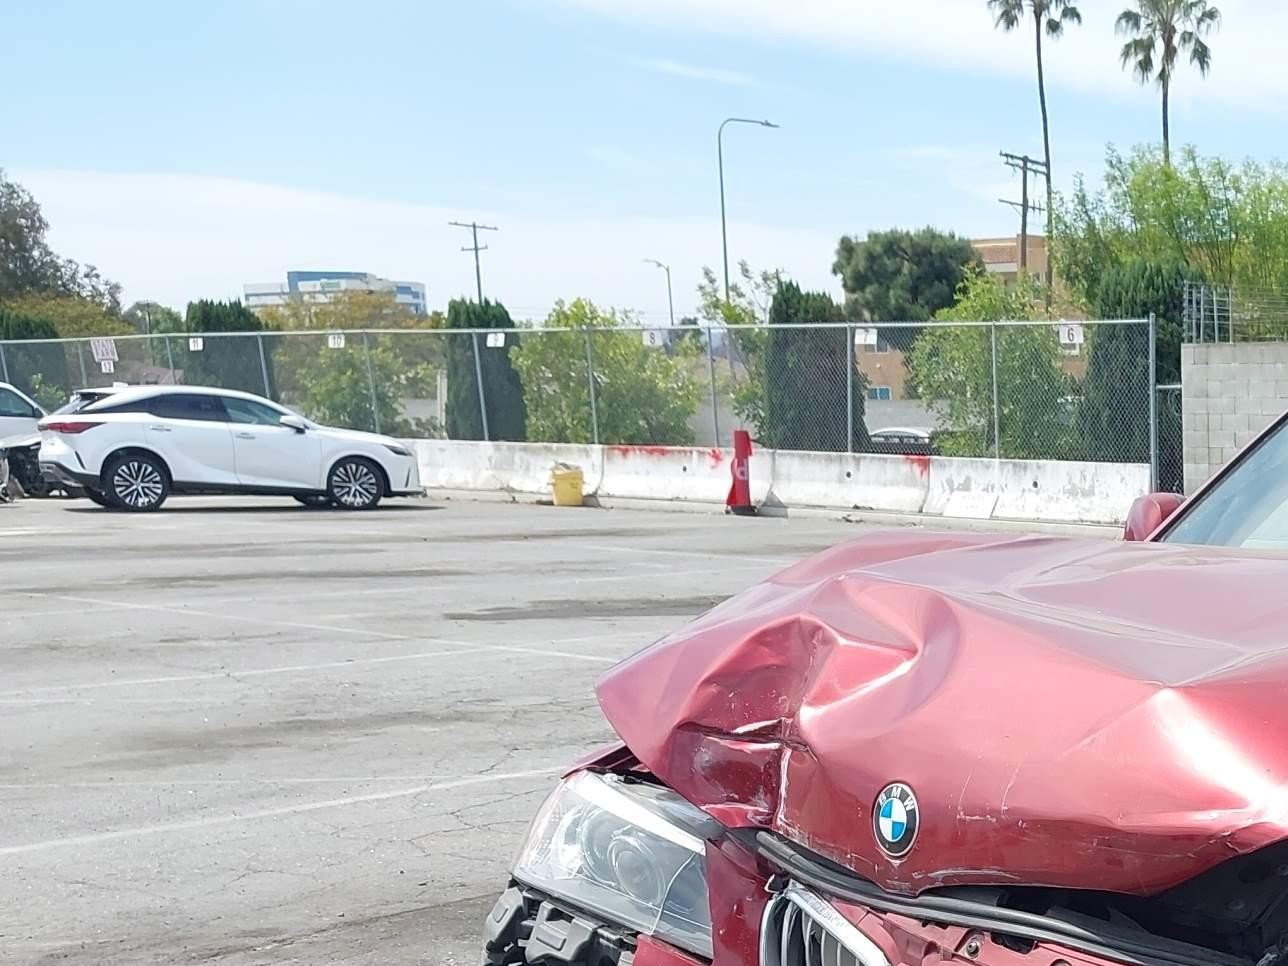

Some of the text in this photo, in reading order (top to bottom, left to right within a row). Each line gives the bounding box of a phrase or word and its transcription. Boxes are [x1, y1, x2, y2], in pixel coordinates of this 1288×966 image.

[649, 331, 656, 345] 8
[1067, 327, 1075, 342] 6
[879, 785, 915, 812] BMW
